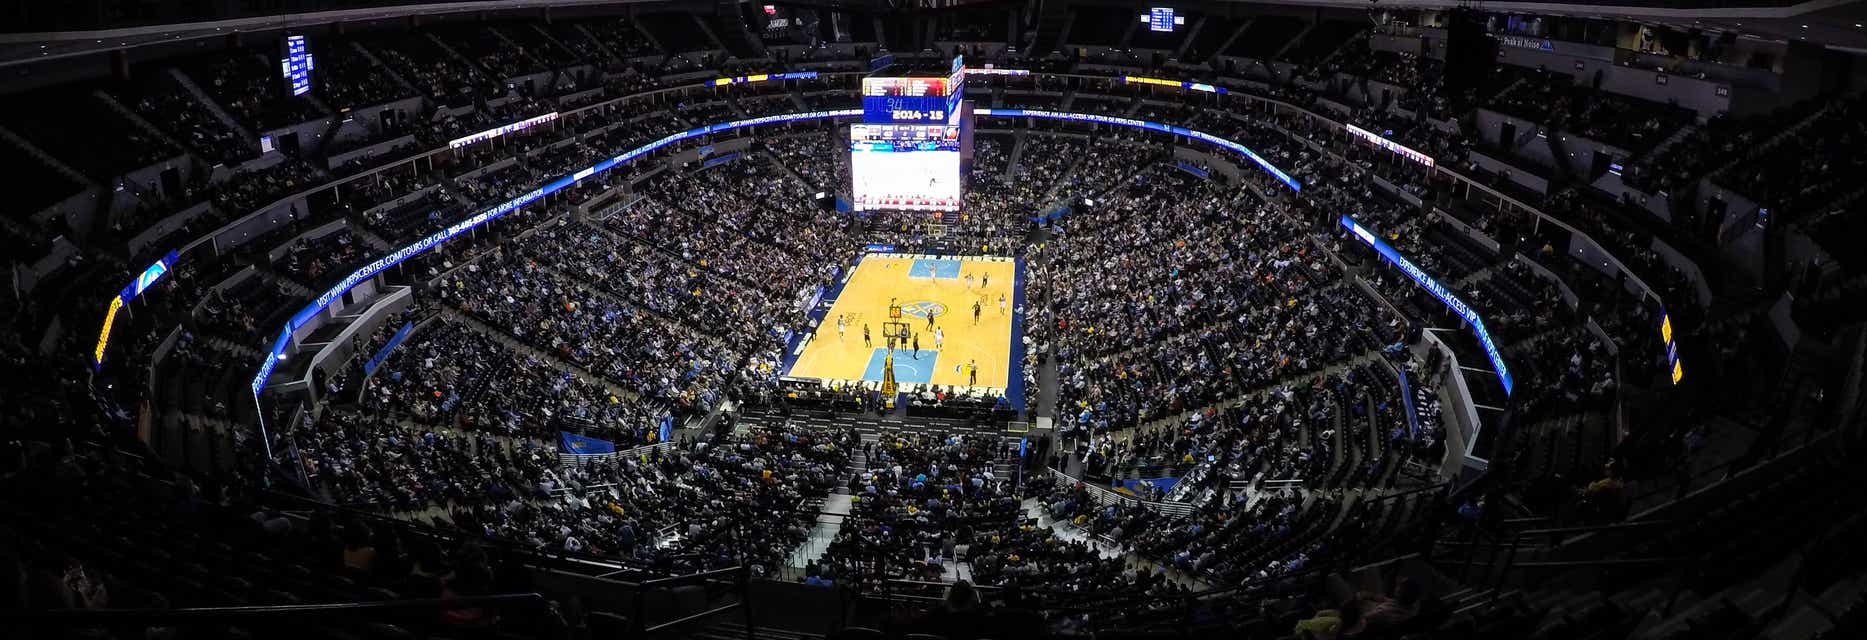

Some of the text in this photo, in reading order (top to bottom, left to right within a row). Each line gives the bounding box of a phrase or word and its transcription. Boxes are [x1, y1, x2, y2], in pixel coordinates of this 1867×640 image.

[317, 291, 332, 307] VISIT
[423, 236, 434, 247] OR
[433, 229, 449, 243] CALL
[487, 207, 499, 219] FOR
[1399, 256, 1427, 284] EXPERIENCE
[1426, 276, 1436, 291] AN
[1434, 282, 1467, 315] ALL-ACCESS
[1465, 307, 1477, 322] VIP
